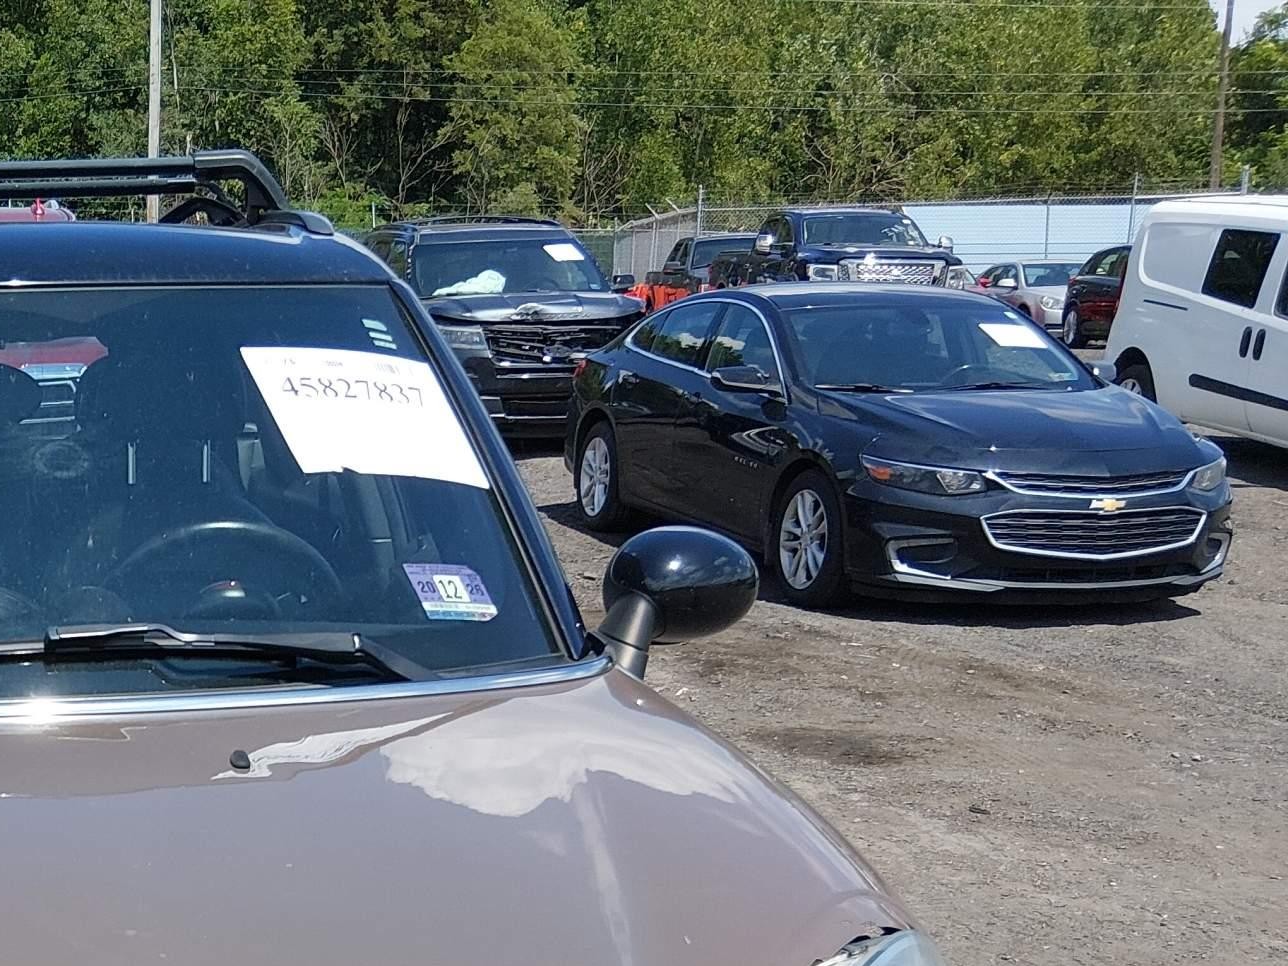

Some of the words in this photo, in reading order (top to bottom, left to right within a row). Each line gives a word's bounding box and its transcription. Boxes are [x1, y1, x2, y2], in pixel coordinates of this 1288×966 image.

[282, 376, 424, 408] 45827837
[417, 580, 437, 594] 20
[438, 579, 463, 600] 12
